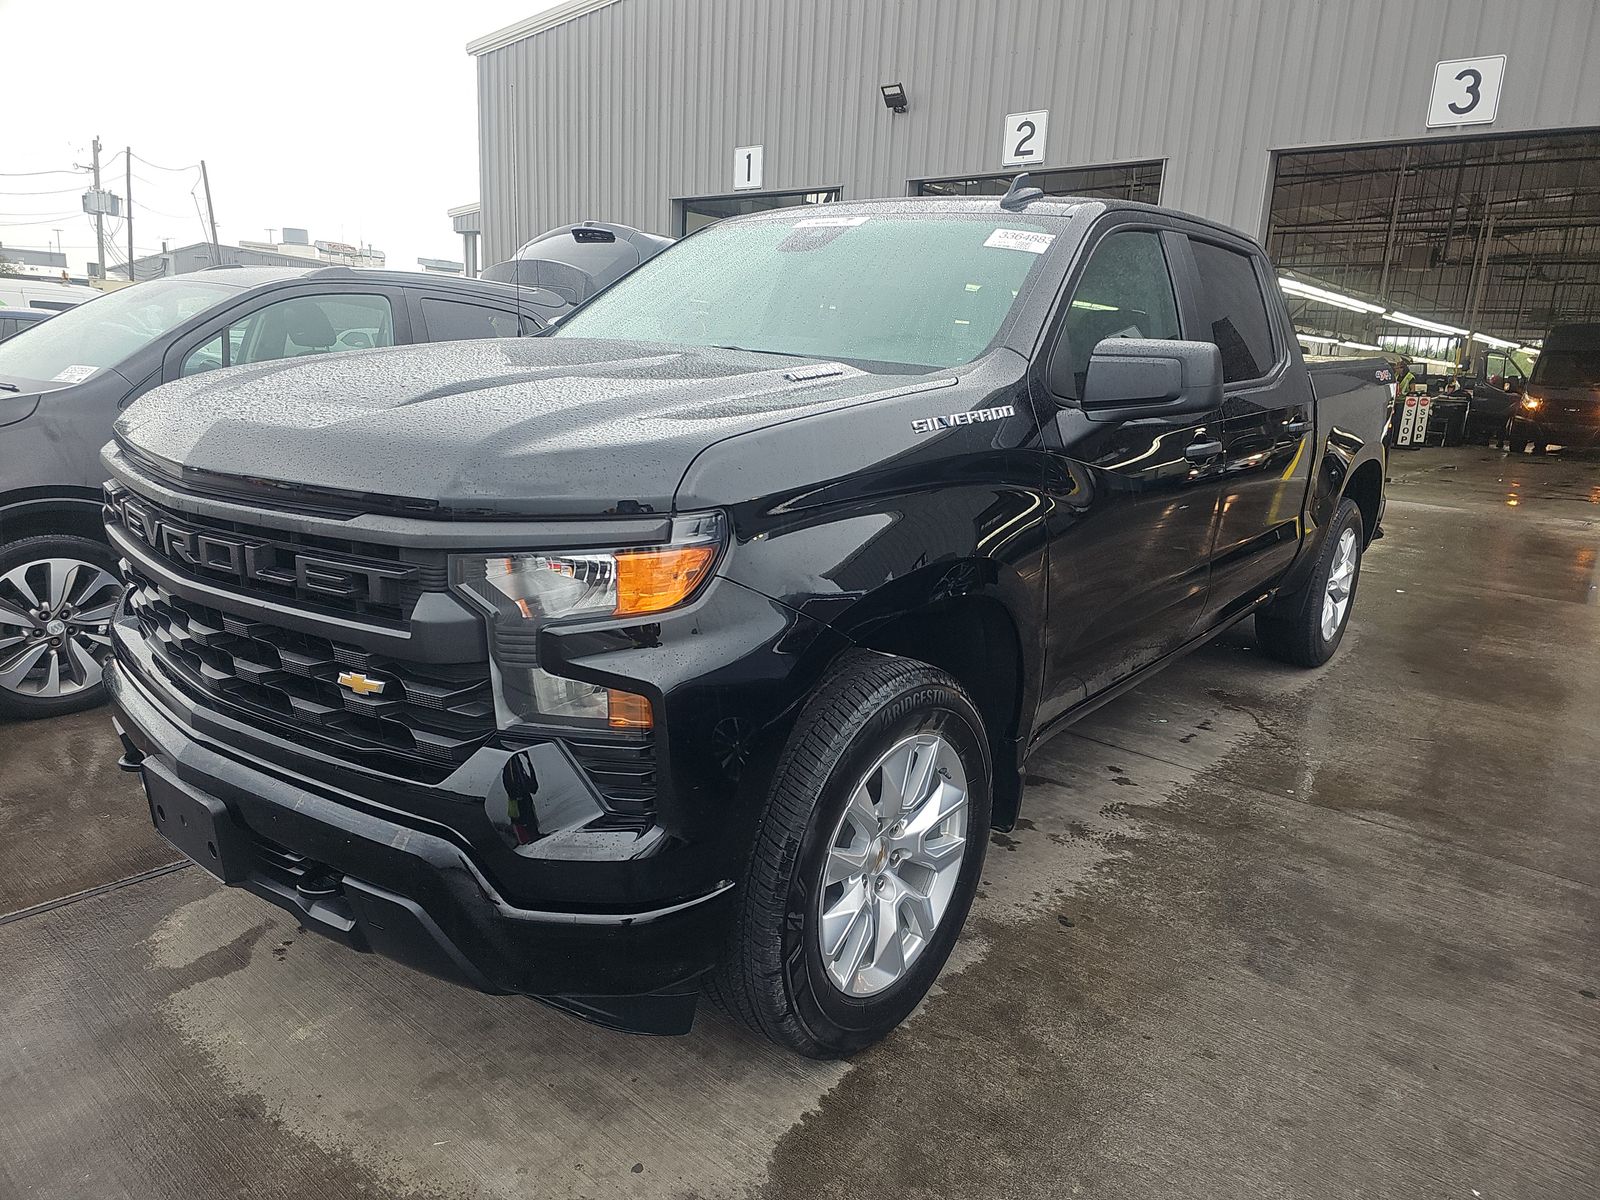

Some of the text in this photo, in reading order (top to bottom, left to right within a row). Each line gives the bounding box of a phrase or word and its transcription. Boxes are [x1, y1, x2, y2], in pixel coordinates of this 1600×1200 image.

[1447, 68, 1483, 115] 3
[1013, 120, 1036, 157] 2
[745, 152, 752, 182] 1
[911, 405, 1016, 434] SILVERADO
[1400, 409, 1413, 443] STOP
[1416, 408, 1426, 440] STOP
[881, 689, 958, 726] BRIDGESTON
